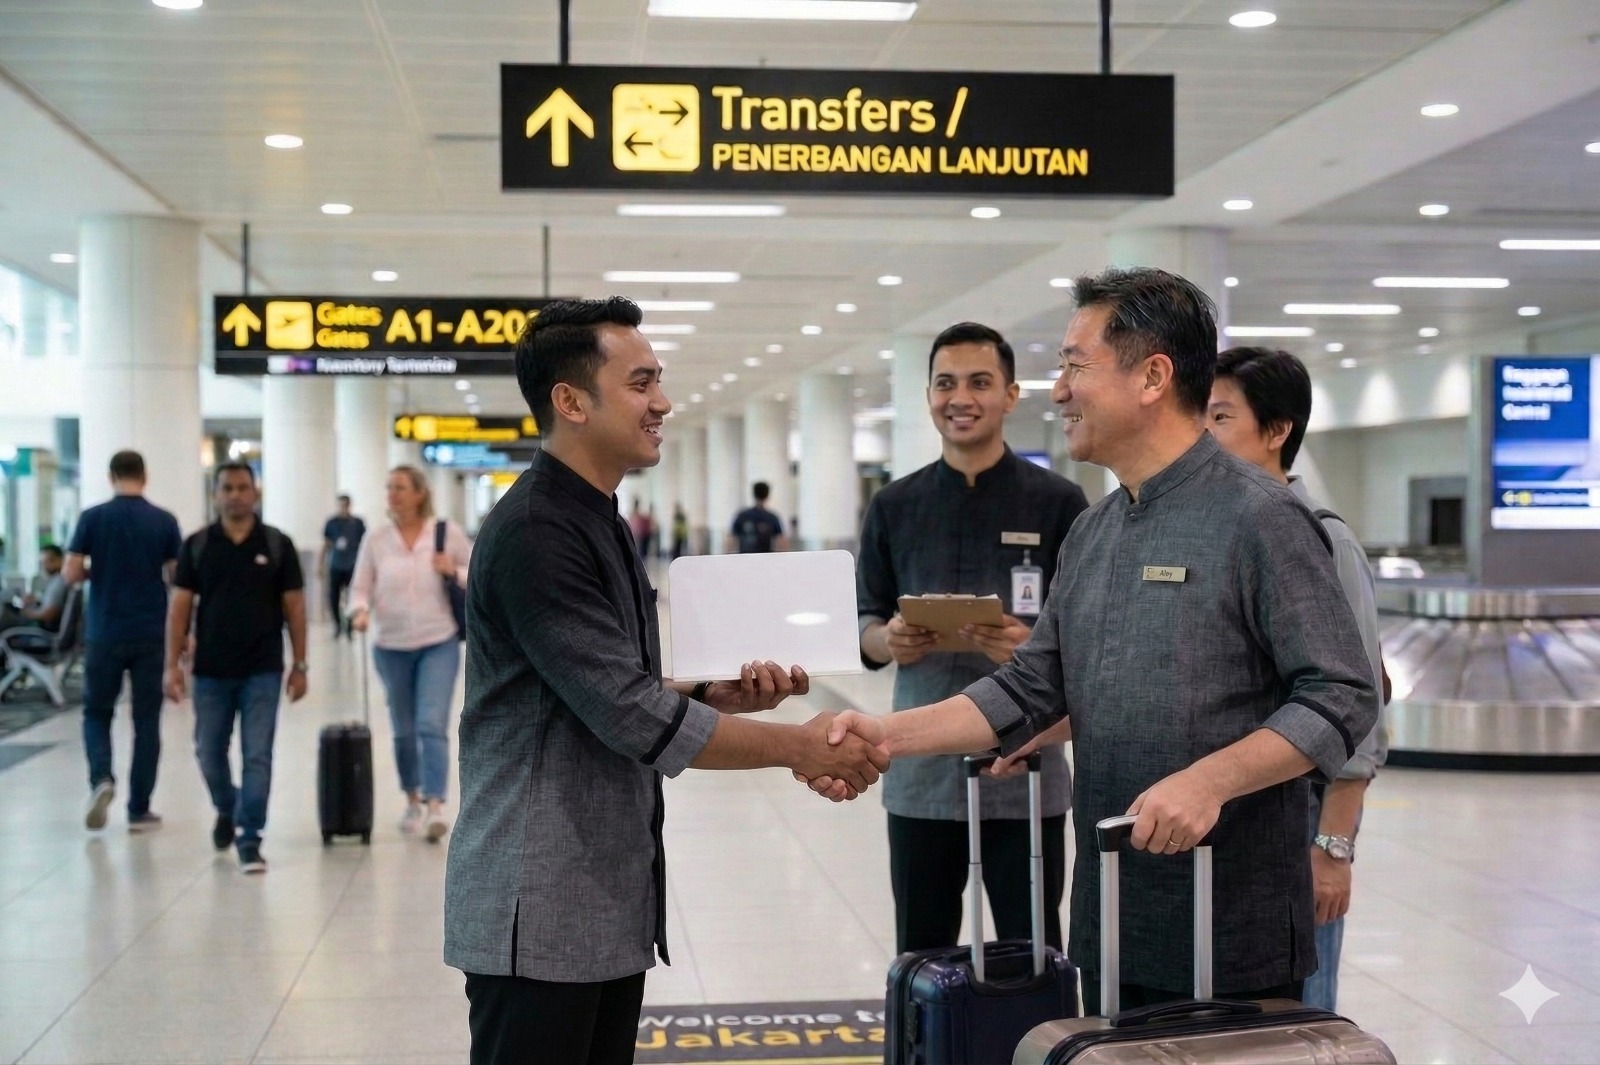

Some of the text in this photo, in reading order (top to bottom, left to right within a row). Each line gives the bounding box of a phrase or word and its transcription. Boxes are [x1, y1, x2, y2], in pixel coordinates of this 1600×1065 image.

[711, 85, 969, 138] Transfers /
[712, 143, 1088, 176] PENERBANGAN LANJUTAN
[385, 308, 541, 344] A1-A20
[638, 1012, 843, 1029] Welcome
